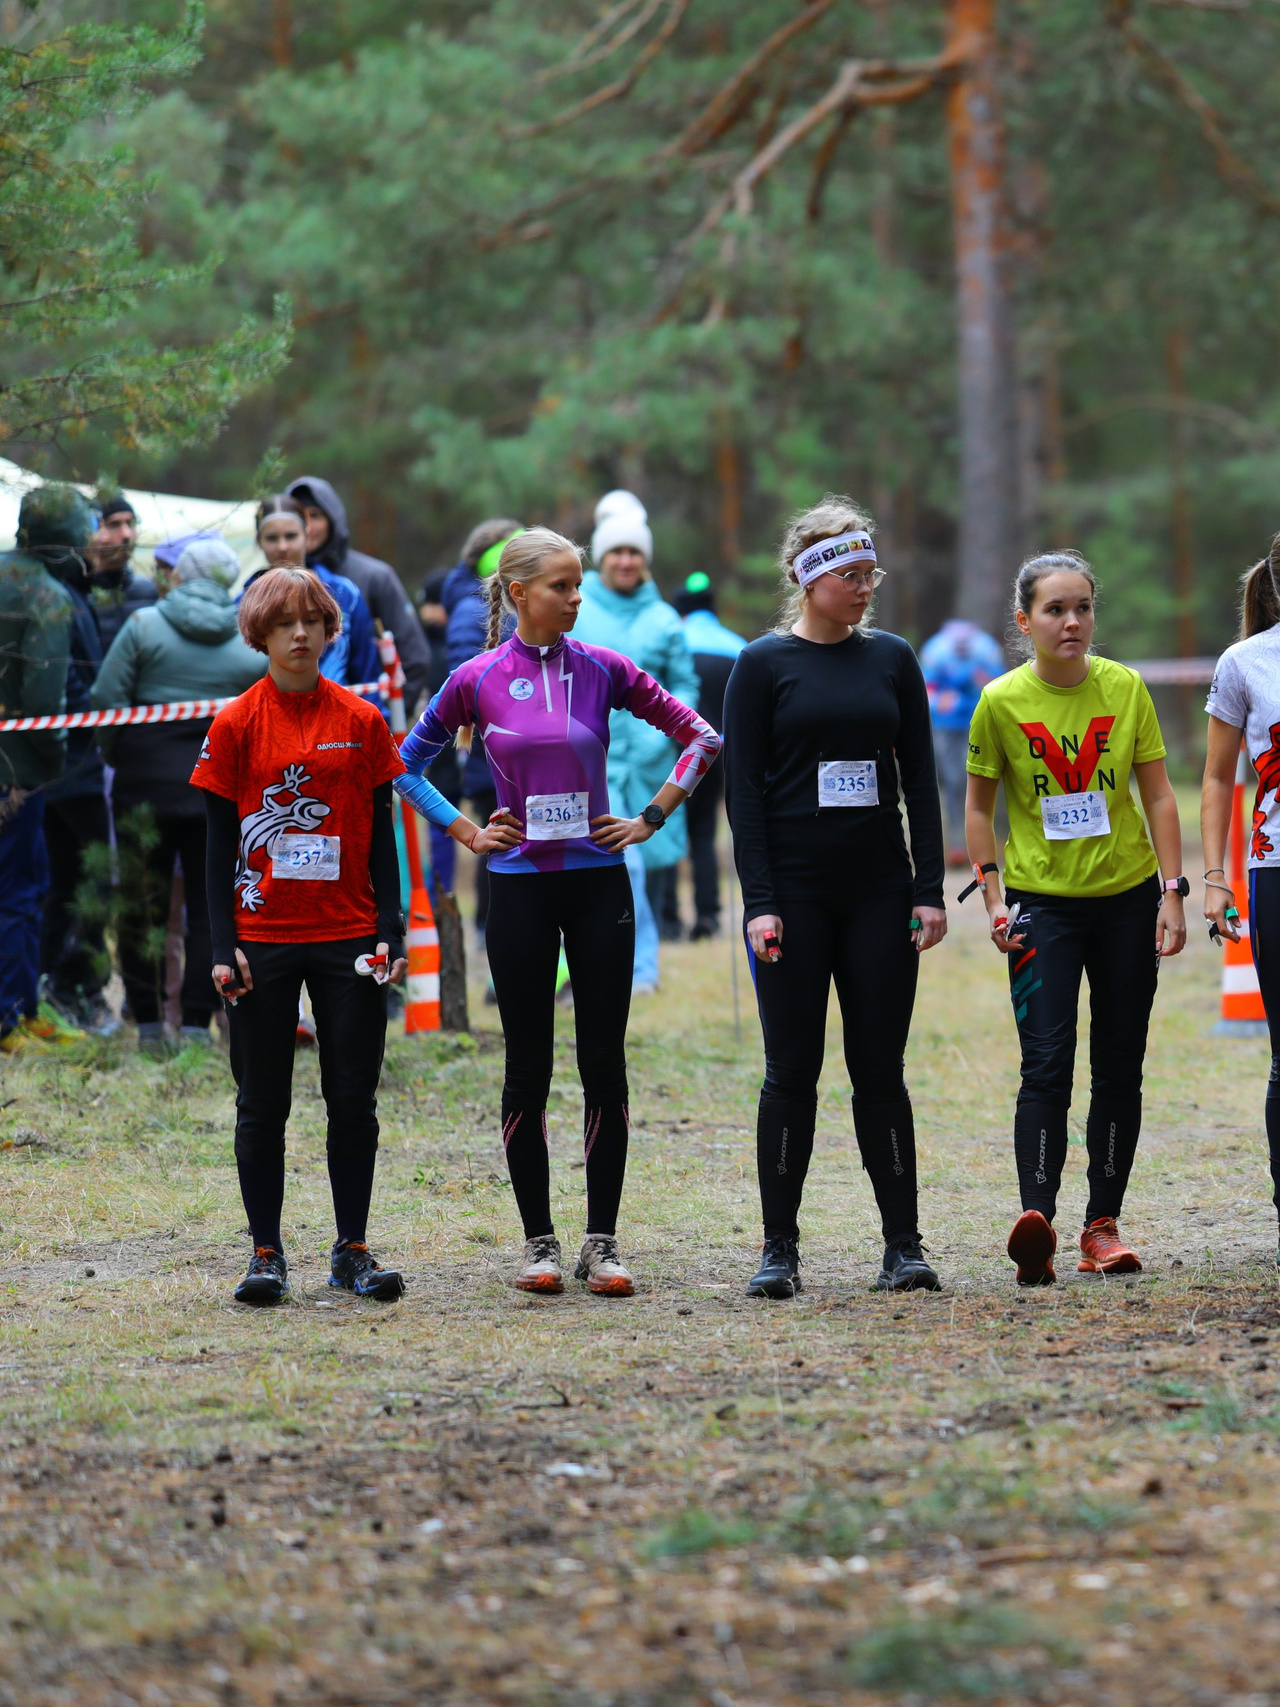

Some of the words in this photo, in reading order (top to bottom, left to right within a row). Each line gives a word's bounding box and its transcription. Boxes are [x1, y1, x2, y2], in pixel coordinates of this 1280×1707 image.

[969, 743, 980, 754] СБ
[1029, 731, 1110, 759] ONE
[838, 777, 865, 791] 235
[1033, 768, 1116, 796] RUN
[545, 807, 571, 822] 236
[1061, 808, 1089, 825] 232
[292, 851, 321, 866] 237
